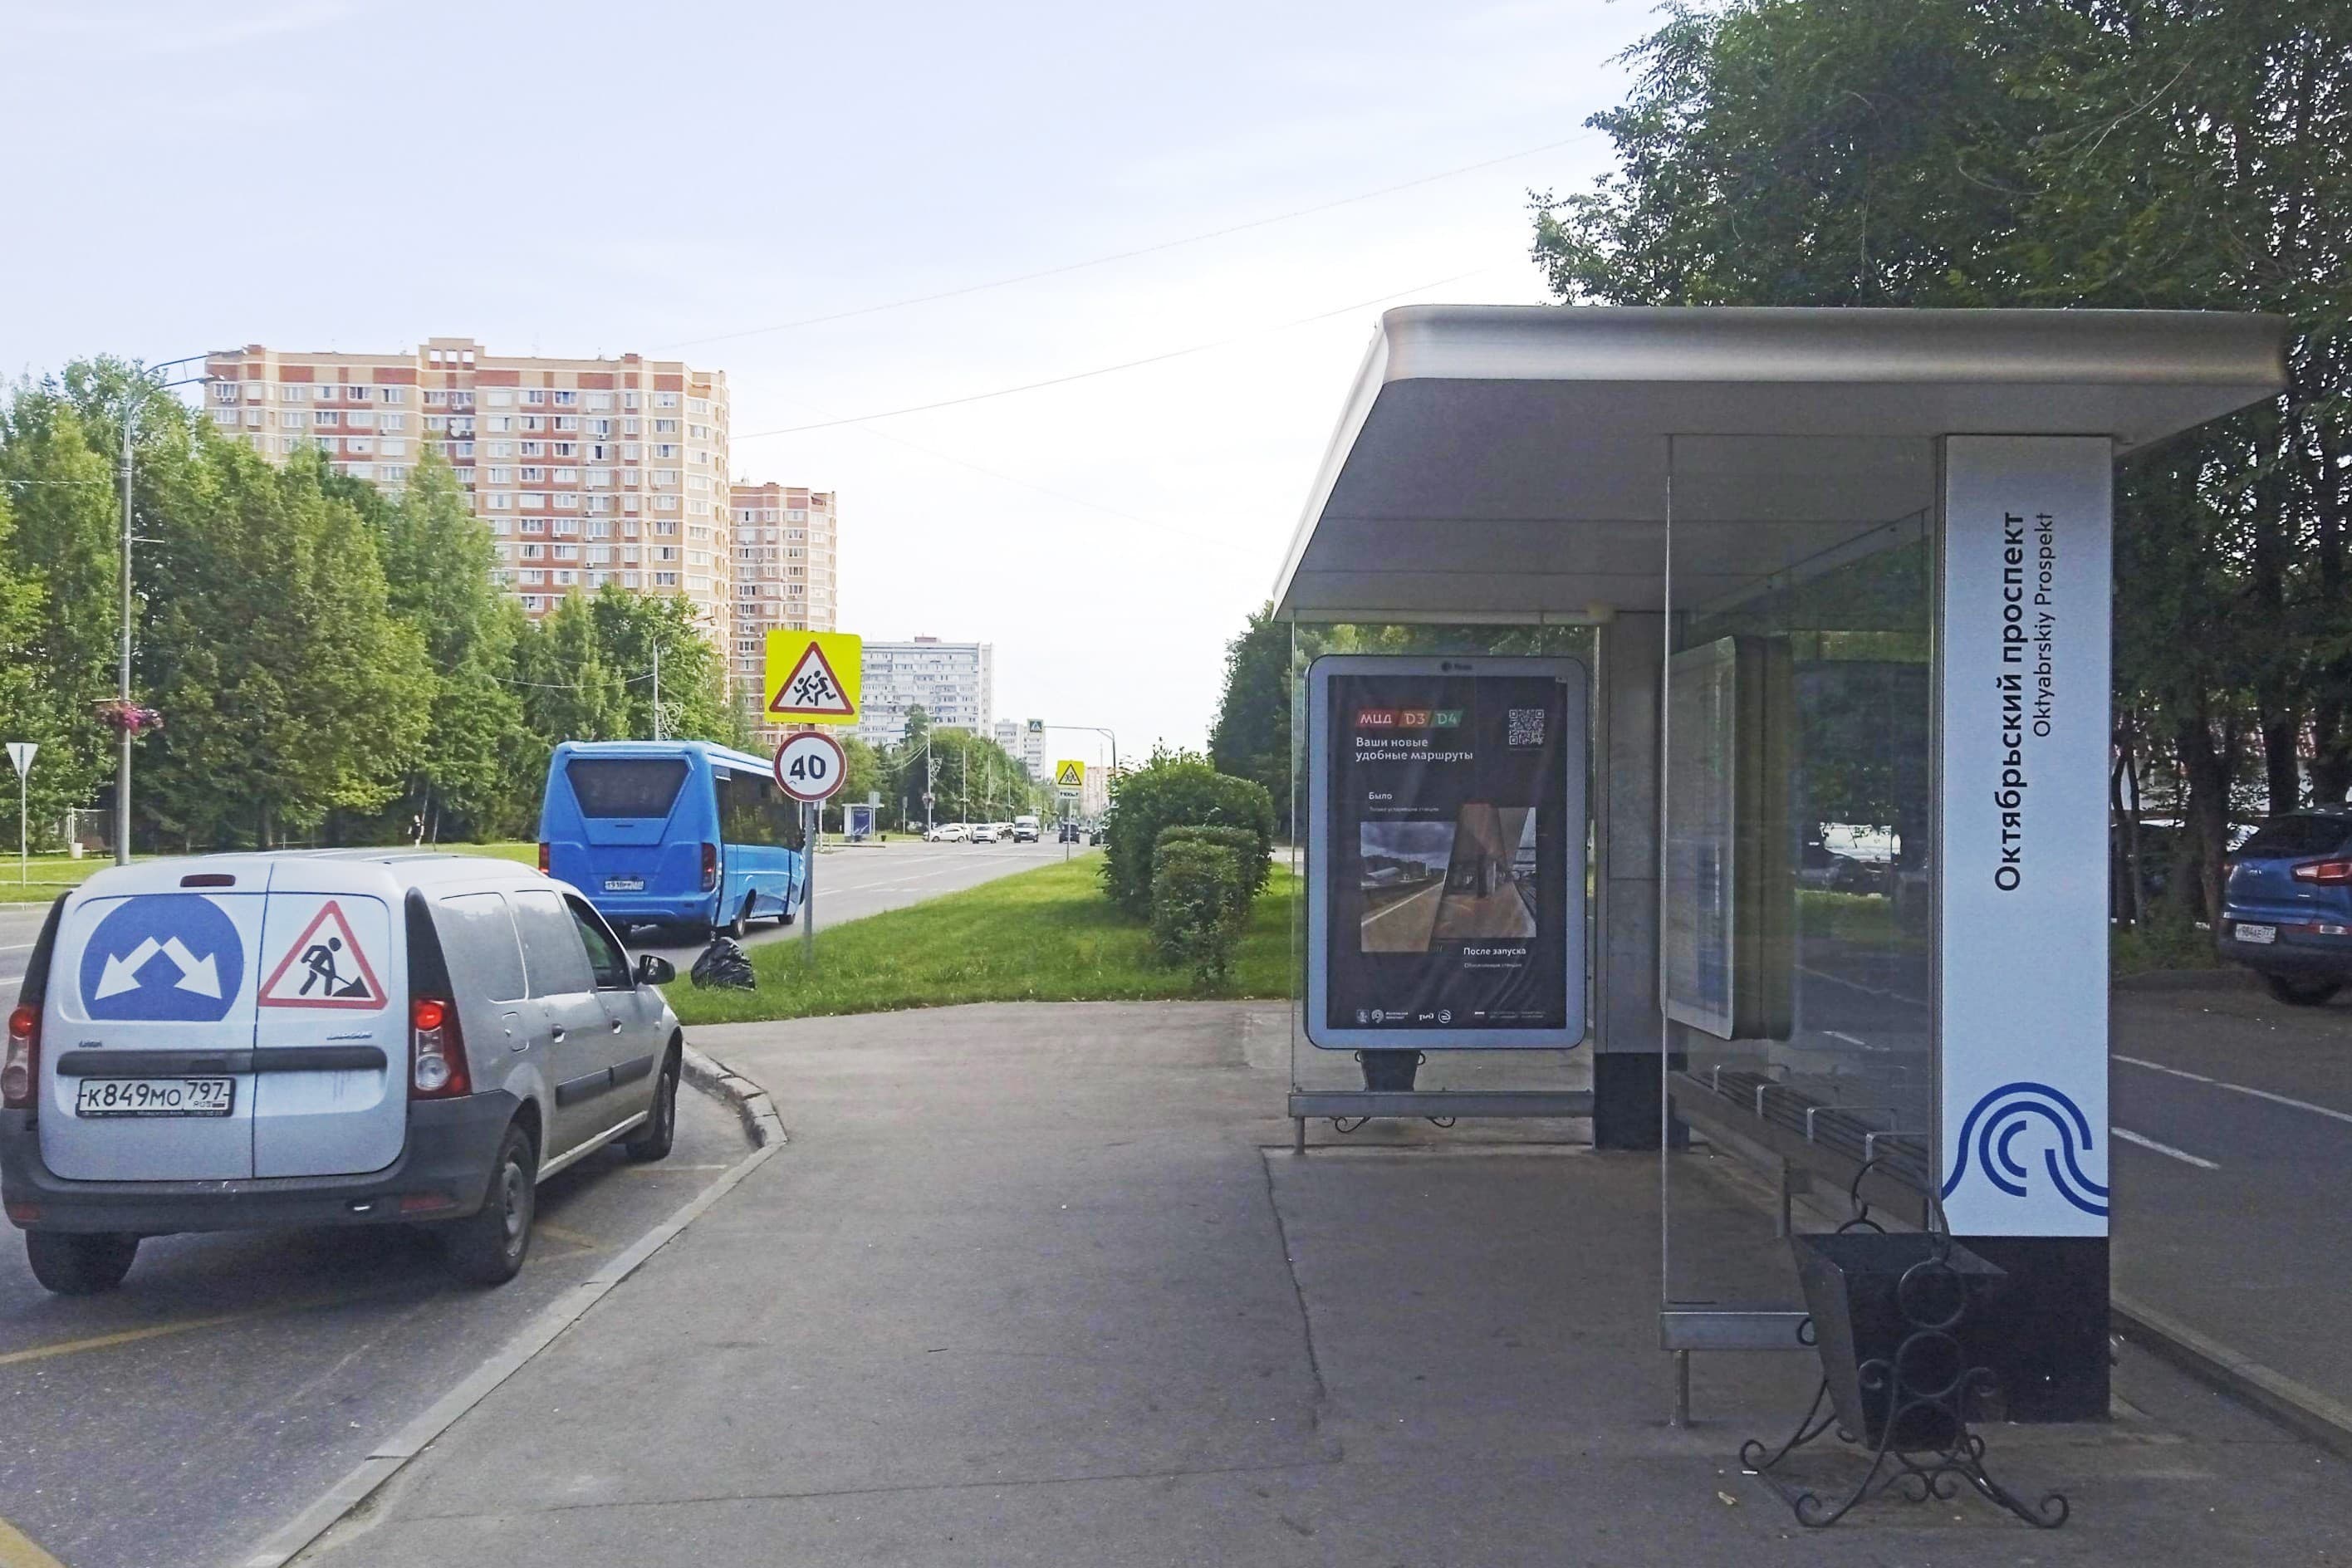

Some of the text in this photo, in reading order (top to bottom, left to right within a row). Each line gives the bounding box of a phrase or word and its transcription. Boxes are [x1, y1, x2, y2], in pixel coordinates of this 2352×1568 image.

[2033, 512, 2056, 737] Oktyabrskiy Prospekt
[1994, 512, 2028, 891] Октябрьский проспект
[1360, 713, 1458, 725] МЦД D3 D4
[1356, 737, 1428, 747] Ваши новые
[1355, 750, 1473, 762] удобные маршруты
[790, 754, 826, 781] 40
[1369, 791, 1393, 800] Было
[1463, 947, 1526, 957] После запуска
[87, 1081, 225, 1107] К849МО 797
